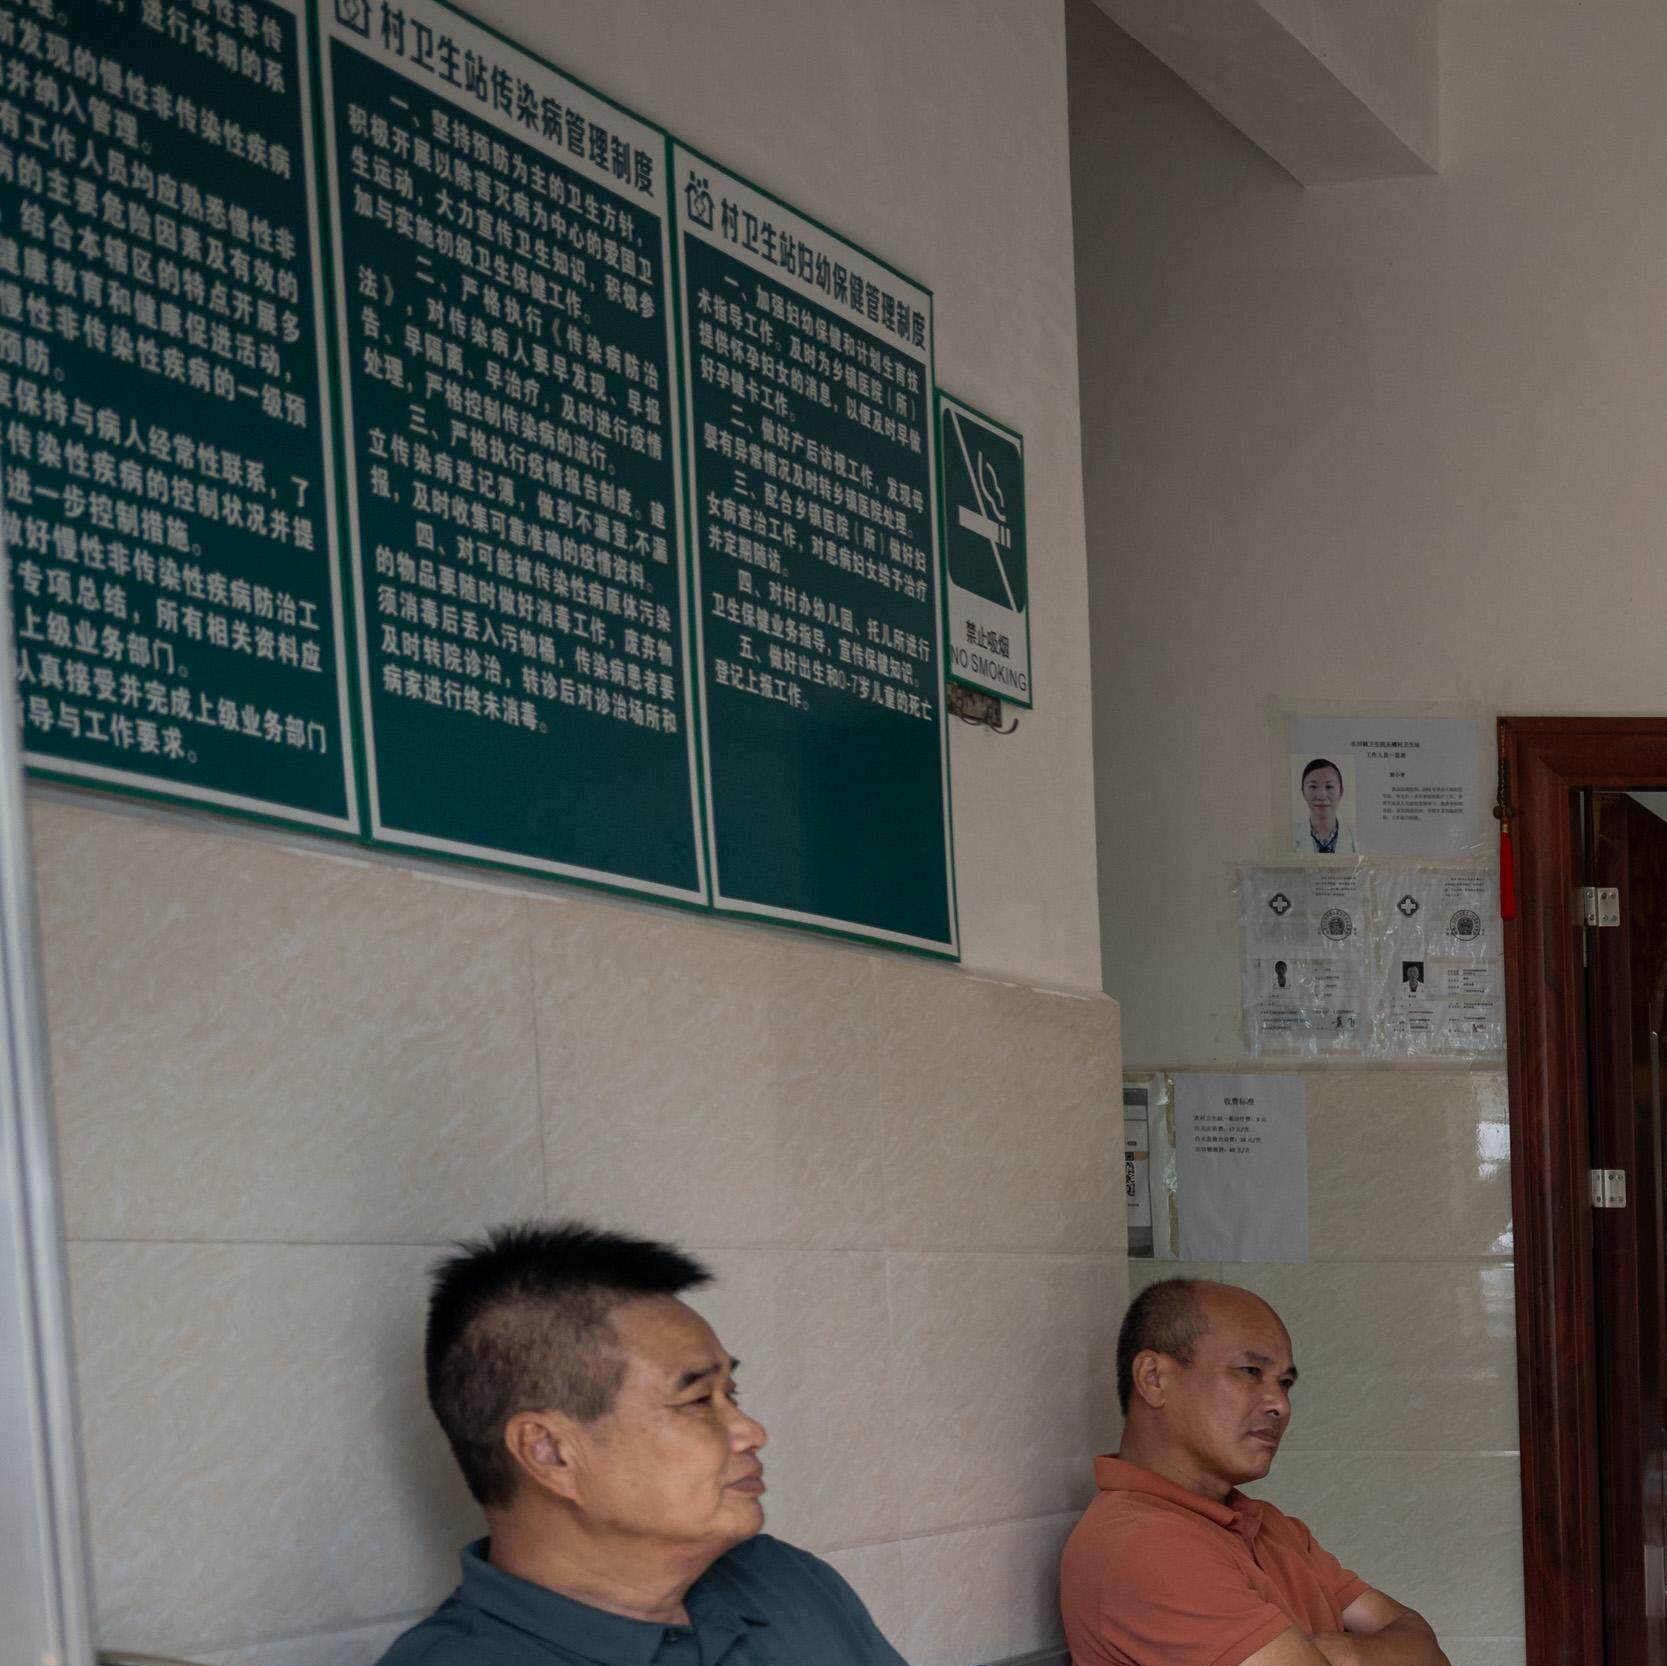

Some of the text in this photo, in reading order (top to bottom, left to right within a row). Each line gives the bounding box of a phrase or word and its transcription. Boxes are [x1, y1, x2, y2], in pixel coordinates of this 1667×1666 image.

[379, 0, 655, 198] 村卫生站传染病管理制度
[352, 182, 592, 327] 加与实施初级卫生保健工作。
[721, 197, 926, 352] 村卫生站妇幼保健管理制度
[362, 343, 618, 477] 处理，严格控制传染病的流行。
[414, 518, 671, 633] 四、对可能被传染性病原体污染
[714, 656, 810, 714] 登记上报工作。
[951, 644, 1027, 692] NO SMOKING
[965, 621, 1010, 659] 禁止吸烟
